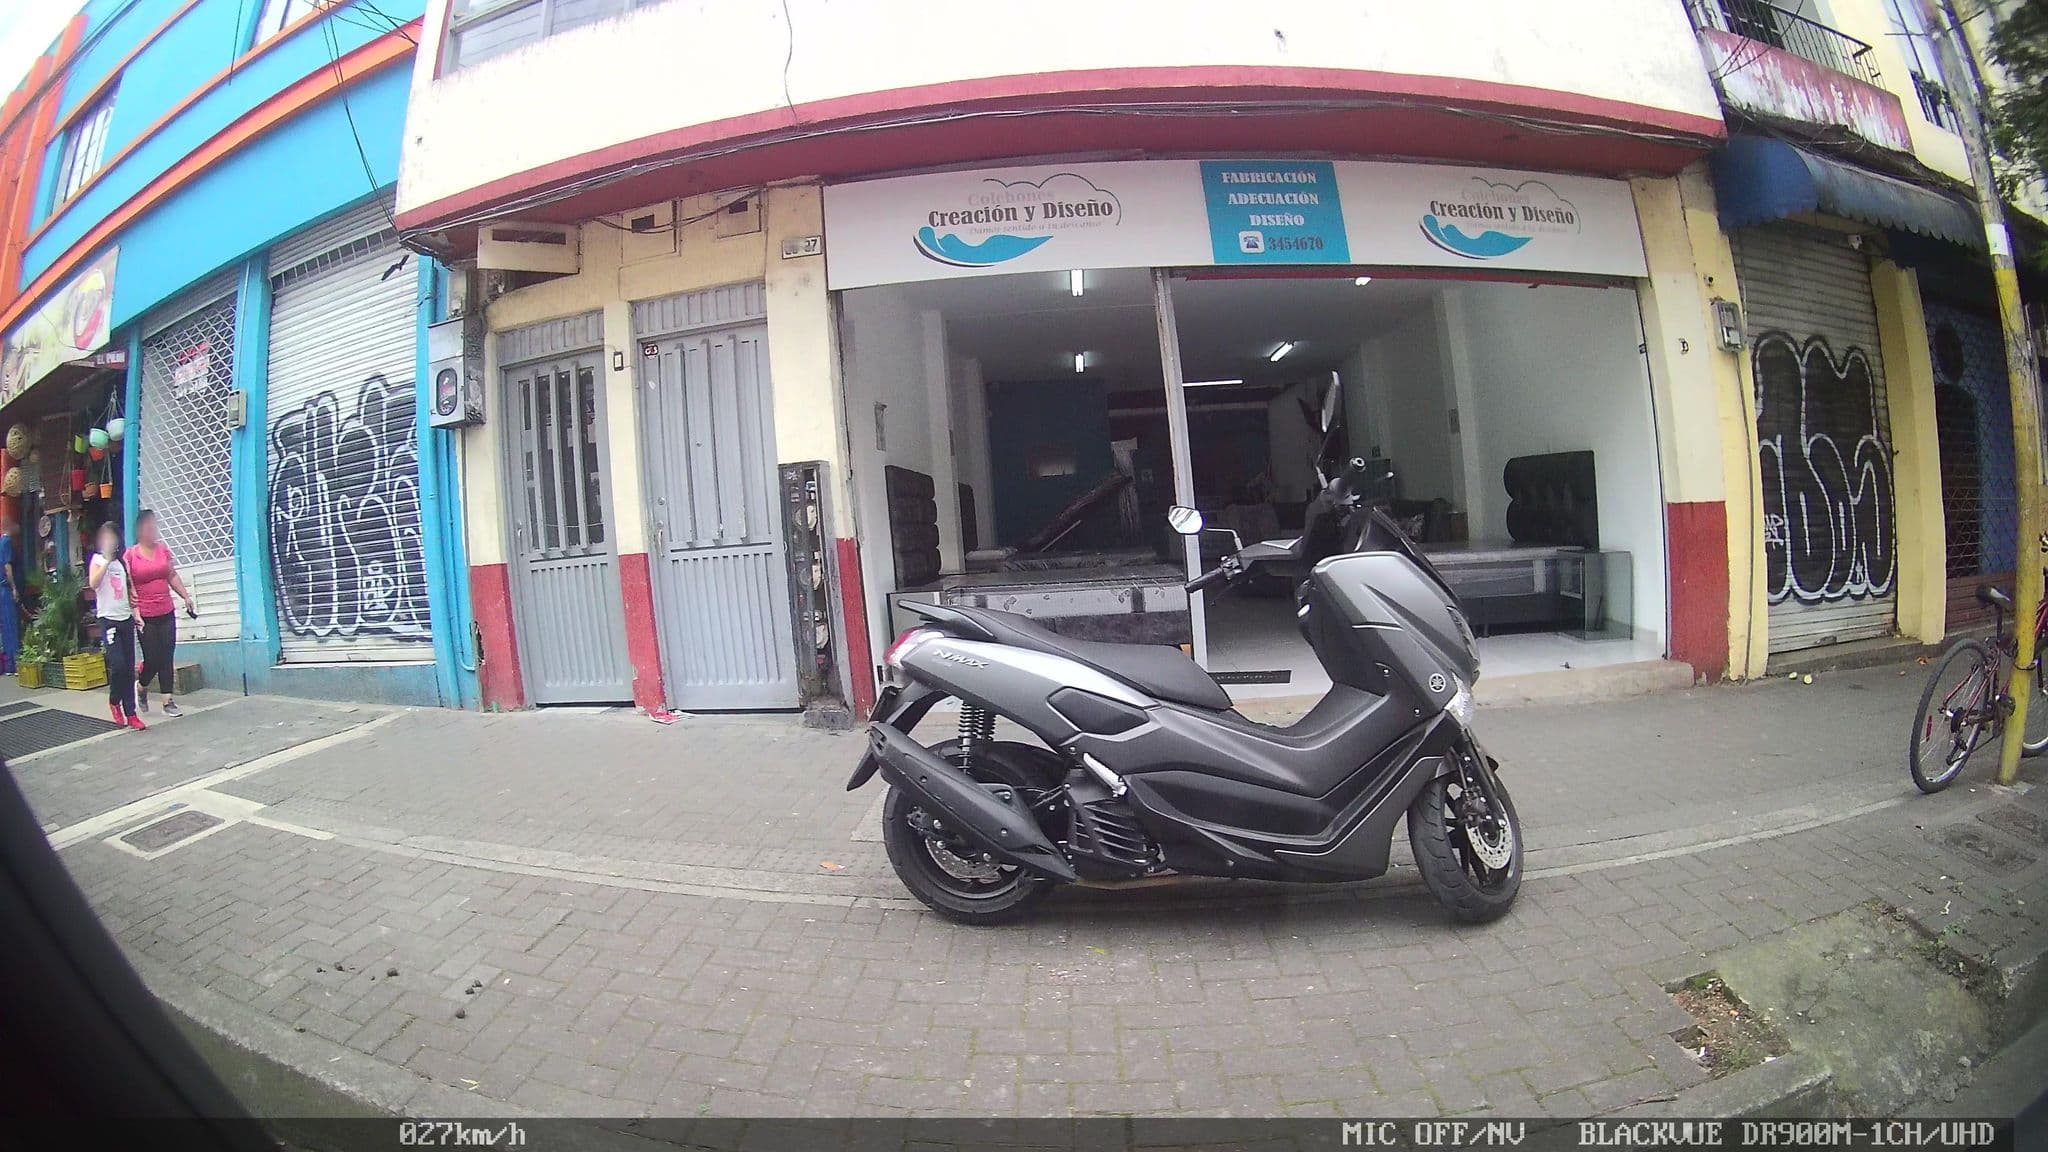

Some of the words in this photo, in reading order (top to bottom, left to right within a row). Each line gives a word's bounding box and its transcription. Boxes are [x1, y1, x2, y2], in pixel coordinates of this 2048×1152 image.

[1222, 169, 1317, 183] FABRICACIÓN
[1228, 191, 1319, 205] ADECUACIÓN
[928, 204, 1018, 228] Creación
[1024, 206, 1036, 222] y
[1042, 199, 1113, 219] Diseño
[1249, 213, 1305, 226] DISEÑO
[1430, 200, 1504, 220] Creación
[1507, 206, 1518, 222] y
[1522, 204, 1575, 225] Diseño
[934, 650, 989, 669] NMAX
